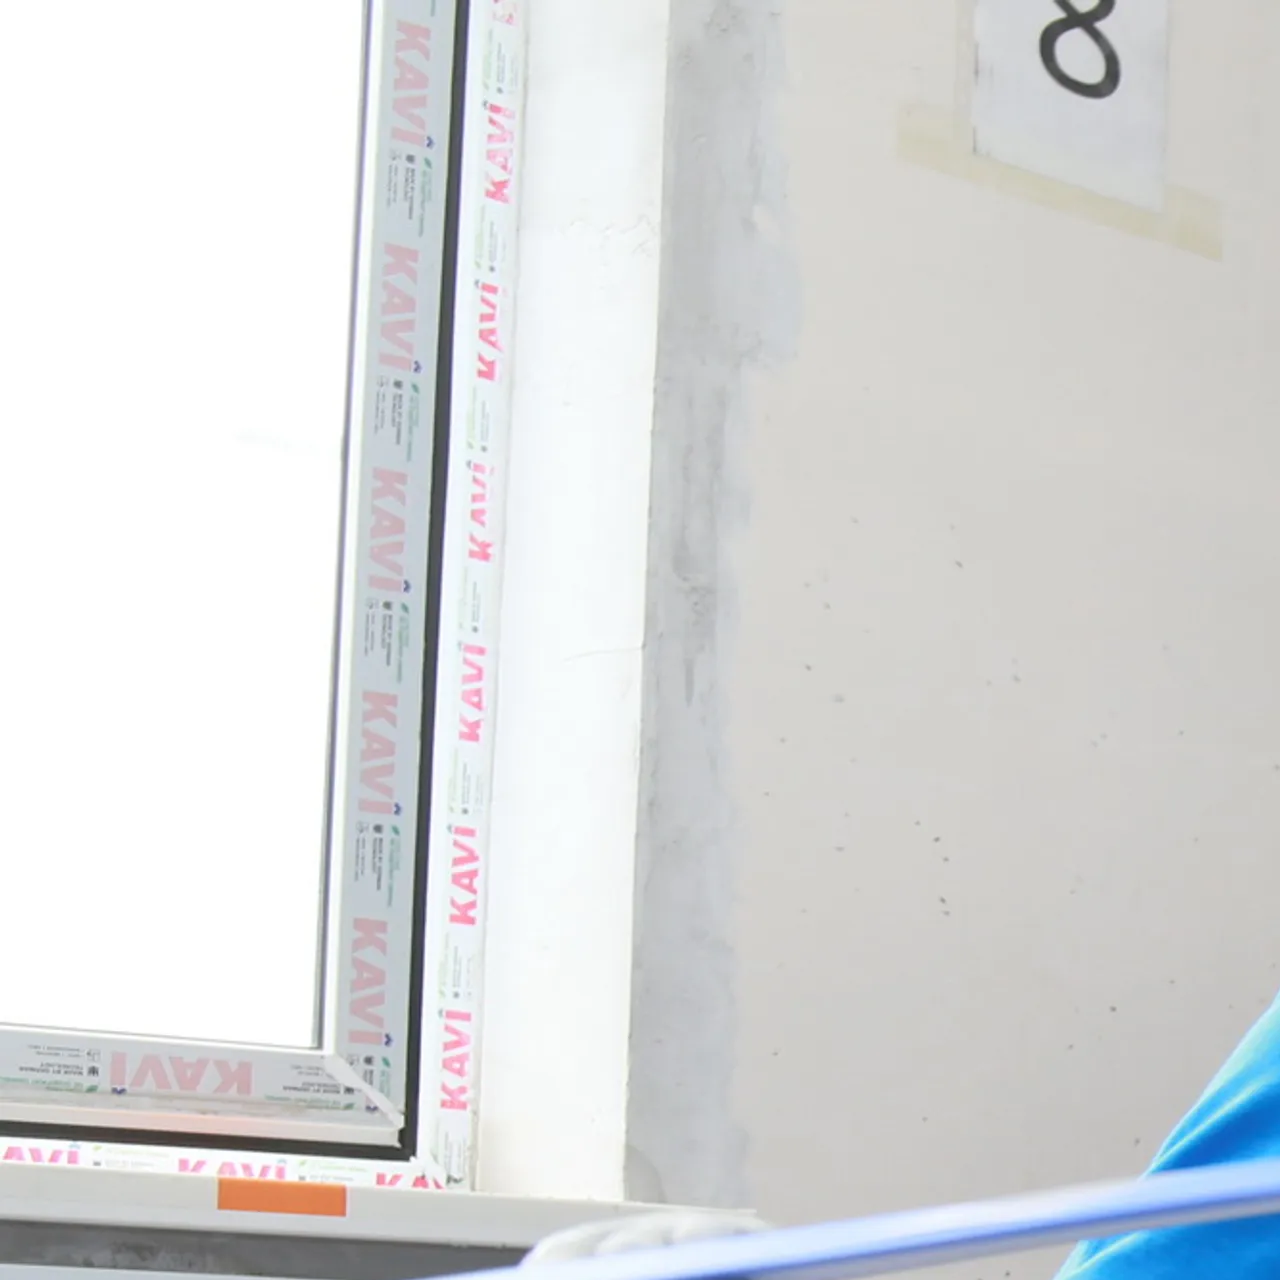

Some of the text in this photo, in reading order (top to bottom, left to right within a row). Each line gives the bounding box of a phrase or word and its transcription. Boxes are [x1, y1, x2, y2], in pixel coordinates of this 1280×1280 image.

[392, 20, 432, 148] KAVI
[379, 242, 420, 372] KAVI
[368, 467, 408, 593] KAVI
[359, 690, 399, 815] KAVI
[459, 644, 487, 742] KAVI
[449, 826, 479, 926] KAVI
[348, 917, 389, 1045] KAVI
[110, 1052, 253, 1096] KAVI
[440, 1010, 472, 1110] KAVI
